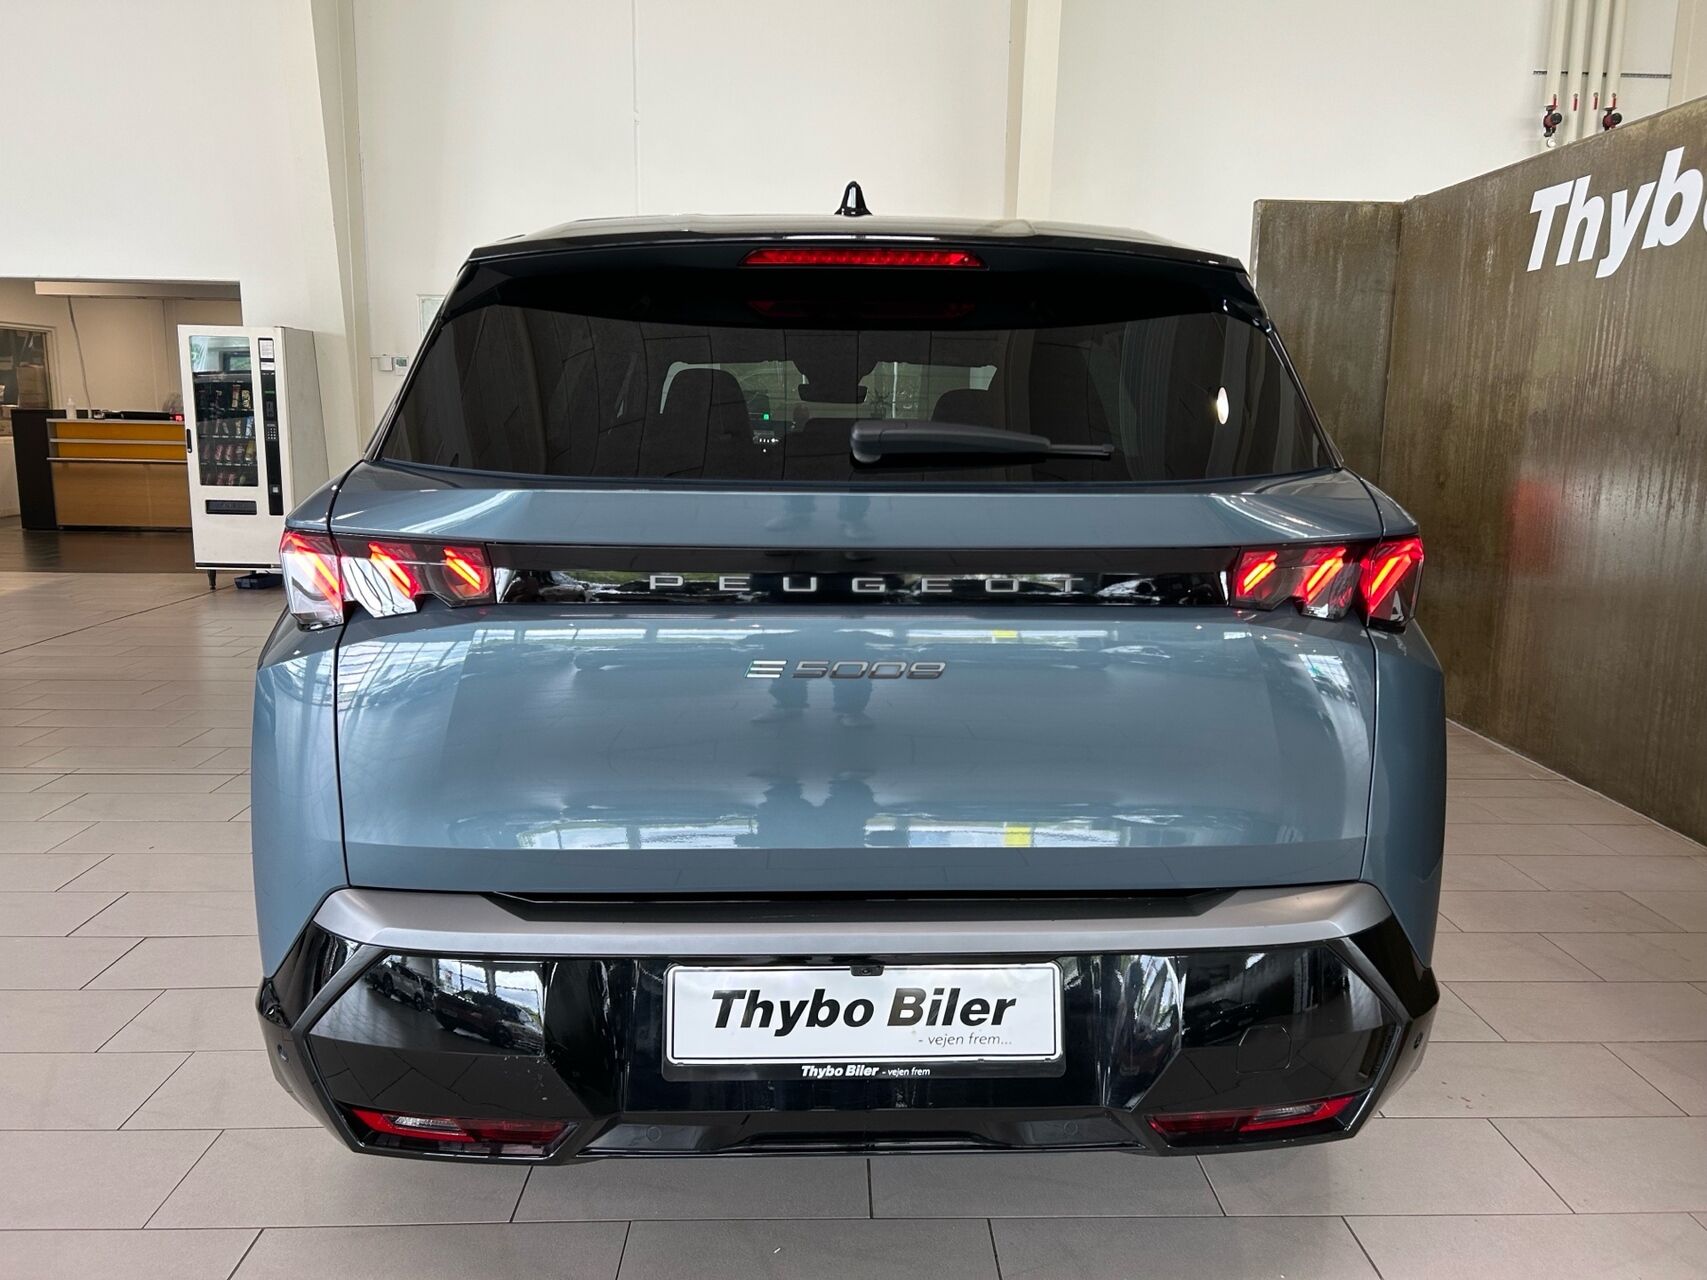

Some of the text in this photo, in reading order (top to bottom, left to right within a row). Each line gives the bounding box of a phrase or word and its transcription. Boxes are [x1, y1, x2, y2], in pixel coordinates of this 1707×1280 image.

[1526, 145, 1707, 279] Thyb
[648, 574, 1085, 593] PEUGEOT
[792, 660, 946, 679] 5009
[711, 987, 1017, 1037] Thybo Biler
[928, 1033, 964, 1047] vejen
[801, 1065, 844, 1079] Thybo
[845, 1064, 879, 1077] Biler
[887, 1068, 909, 1077] vejen
[911, 1067, 931, 1076] frem
